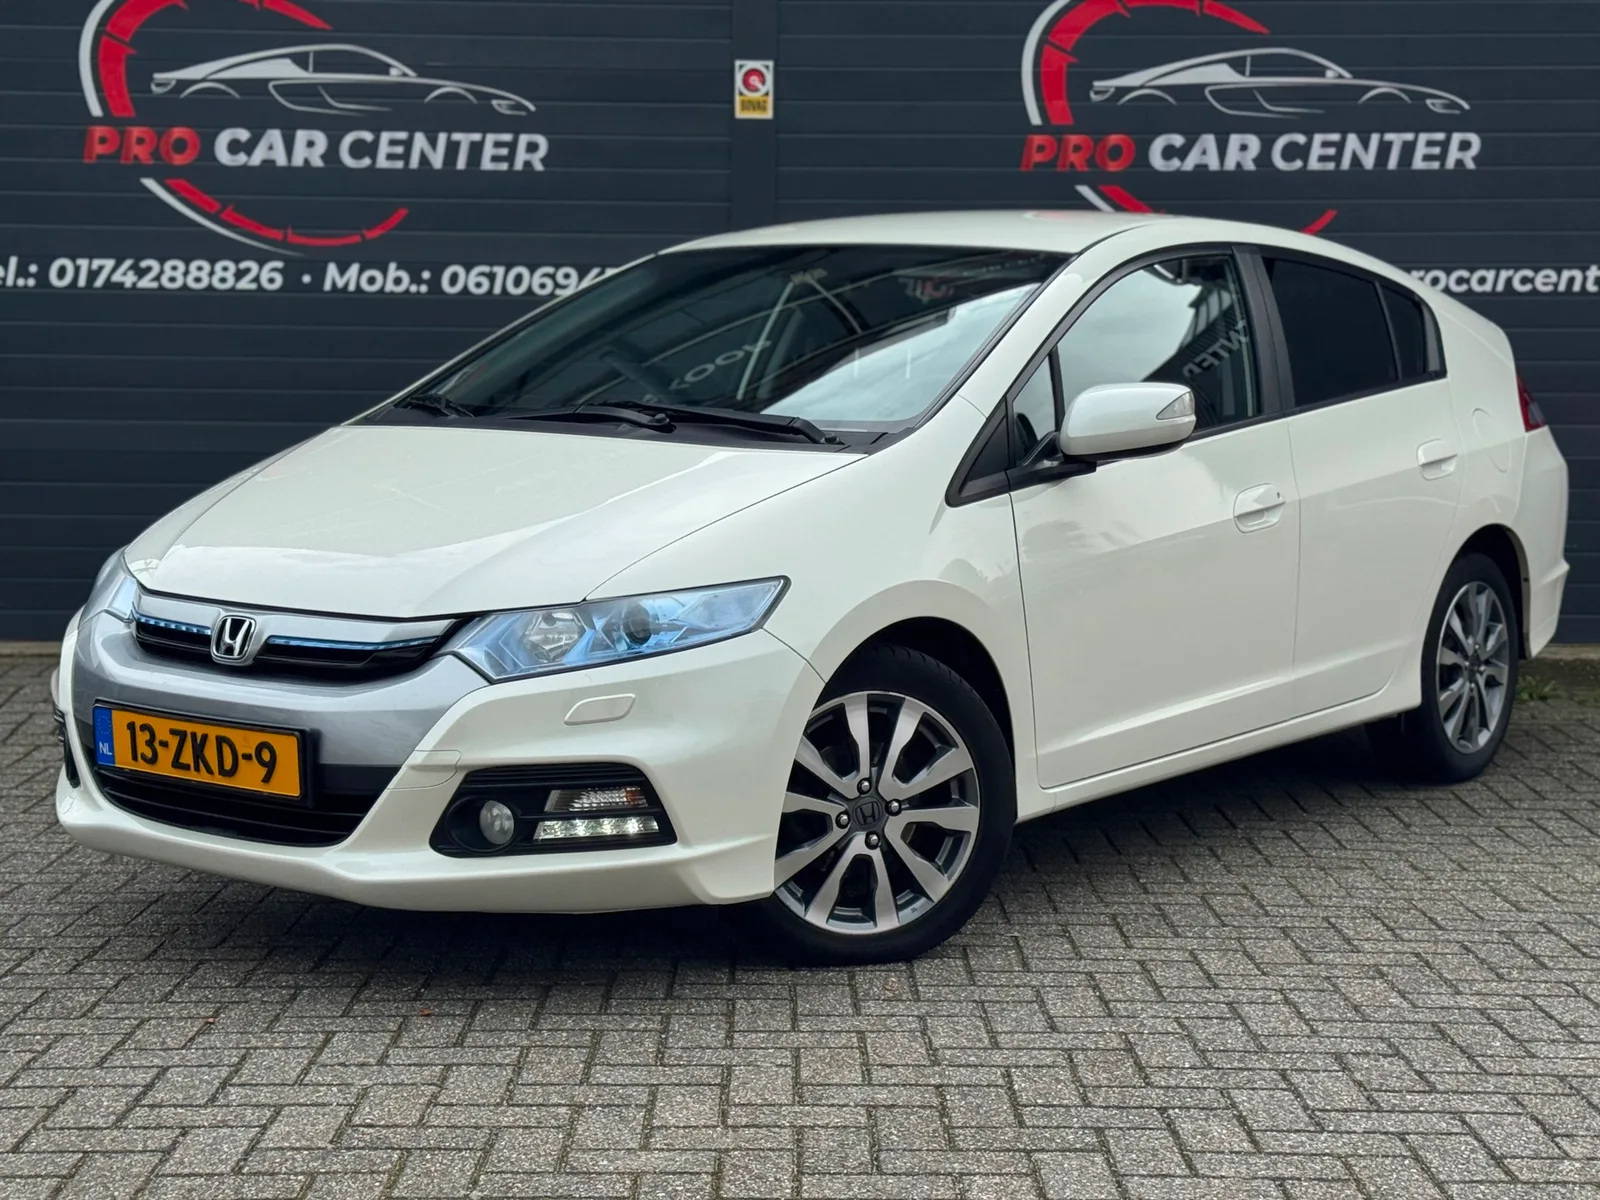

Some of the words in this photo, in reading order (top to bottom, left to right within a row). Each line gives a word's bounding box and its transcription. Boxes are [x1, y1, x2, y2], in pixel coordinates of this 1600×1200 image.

[83, 126, 200, 164] PRO
[213, 127, 328, 167] CAR
[338, 130, 549, 171] CENTER
[1020, 134, 1136, 172] PRO
[1148, 133, 1261, 172] CAR
[1271, 132, 1481, 171] CENTER
[0, 256, 38, 288] l.:
[48, 257, 284, 291] 0174288826
[323, 261, 430, 294] Mob.:
[440, 264, 619, 297] 061069
[99, 740, 112, 756] NL
[126, 720, 277, 784] 13-ZKD-9
